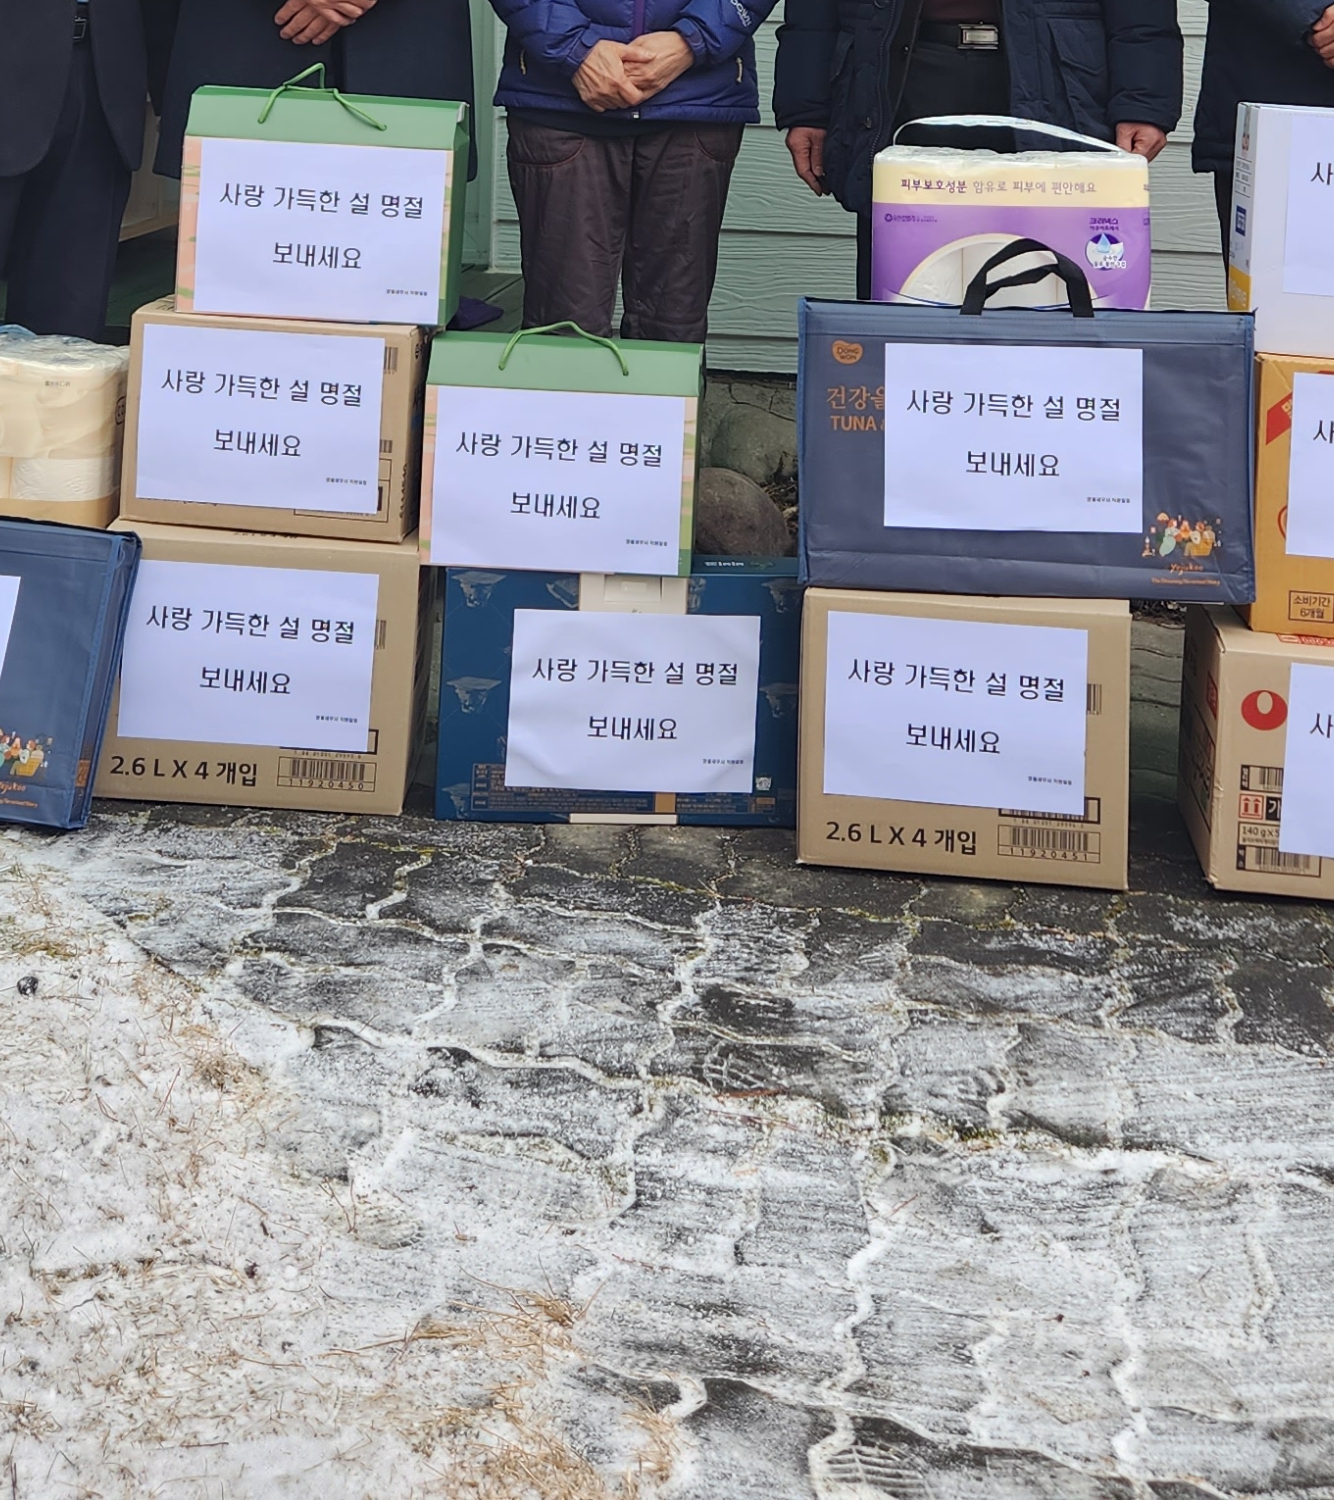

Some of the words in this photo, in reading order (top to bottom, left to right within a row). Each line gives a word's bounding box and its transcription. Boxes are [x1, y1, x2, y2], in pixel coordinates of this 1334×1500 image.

[900, 178, 967, 194] 피부보호성분
[973, 181, 1008, 194] 함유로
[1012, 181, 1046, 194] 피부에
[220, 183, 264, 207] 사랑
[274, 188, 340, 213] 가득한
[350, 193, 369, 215] 설
[382, 195, 422, 219] 명절
[273, 243, 361, 268] 보내세요
[162, 370, 205, 393] 사랑
[215, 374, 280, 399] 가득한
[290, 380, 308, 402] 설
[321, 382, 361, 407] 명절
[827, 385, 885, 411] 건강을
[907, 390, 953, 414] 사랑
[964, 393, 1033, 418] 가득한
[1044, 396, 1063, 419] 설
[1077, 398, 1119, 421] 명절
[829, 415, 877, 431] TUNA
[214, 430, 300, 456] 보내세요
[456, 432, 501, 456] 사랑
[511, 436, 578, 461] 가득한
[588, 441, 607, 463] 설
[620, 443, 661, 467] 명절
[967, 451, 1059, 476] 보내세요
[511, 492, 599, 518] 보내세요
[1293, 595, 1331, 607] 소비기간
[1299, 607, 1325, 619] 6개월
[147, 606, 192, 630] 사랑
[202, 610, 269, 637] 가득한
[280, 617, 299, 639] 설
[312, 620, 353, 644] 명절
[200, 667, 290, 694] 보내세요
[533, 658, 577, 681] 사랑
[588, 660, 654, 683] 가득한
[665, 662, 683, 684] 설
[697, 663, 737, 685] 명절
[849, 659, 894, 685] 사랑
[906, 665, 975, 693] 가득한
[986, 673, 1006, 696] 설
[1020, 676, 1063, 702] 명절
[588, 716, 677, 740] 보내세요
[907, 724, 1000, 753] 보내세요
[110, 755, 146, 777] 2.6
[153, 758, 165, 777] L
[194, 760, 209, 780] 4
[216, 761, 257, 787] 개입
[826, 821, 862, 843] 2.6
[870, 824, 882, 844] L
[911, 827, 927, 848] 4
[934, 829, 977, 856] 개입
